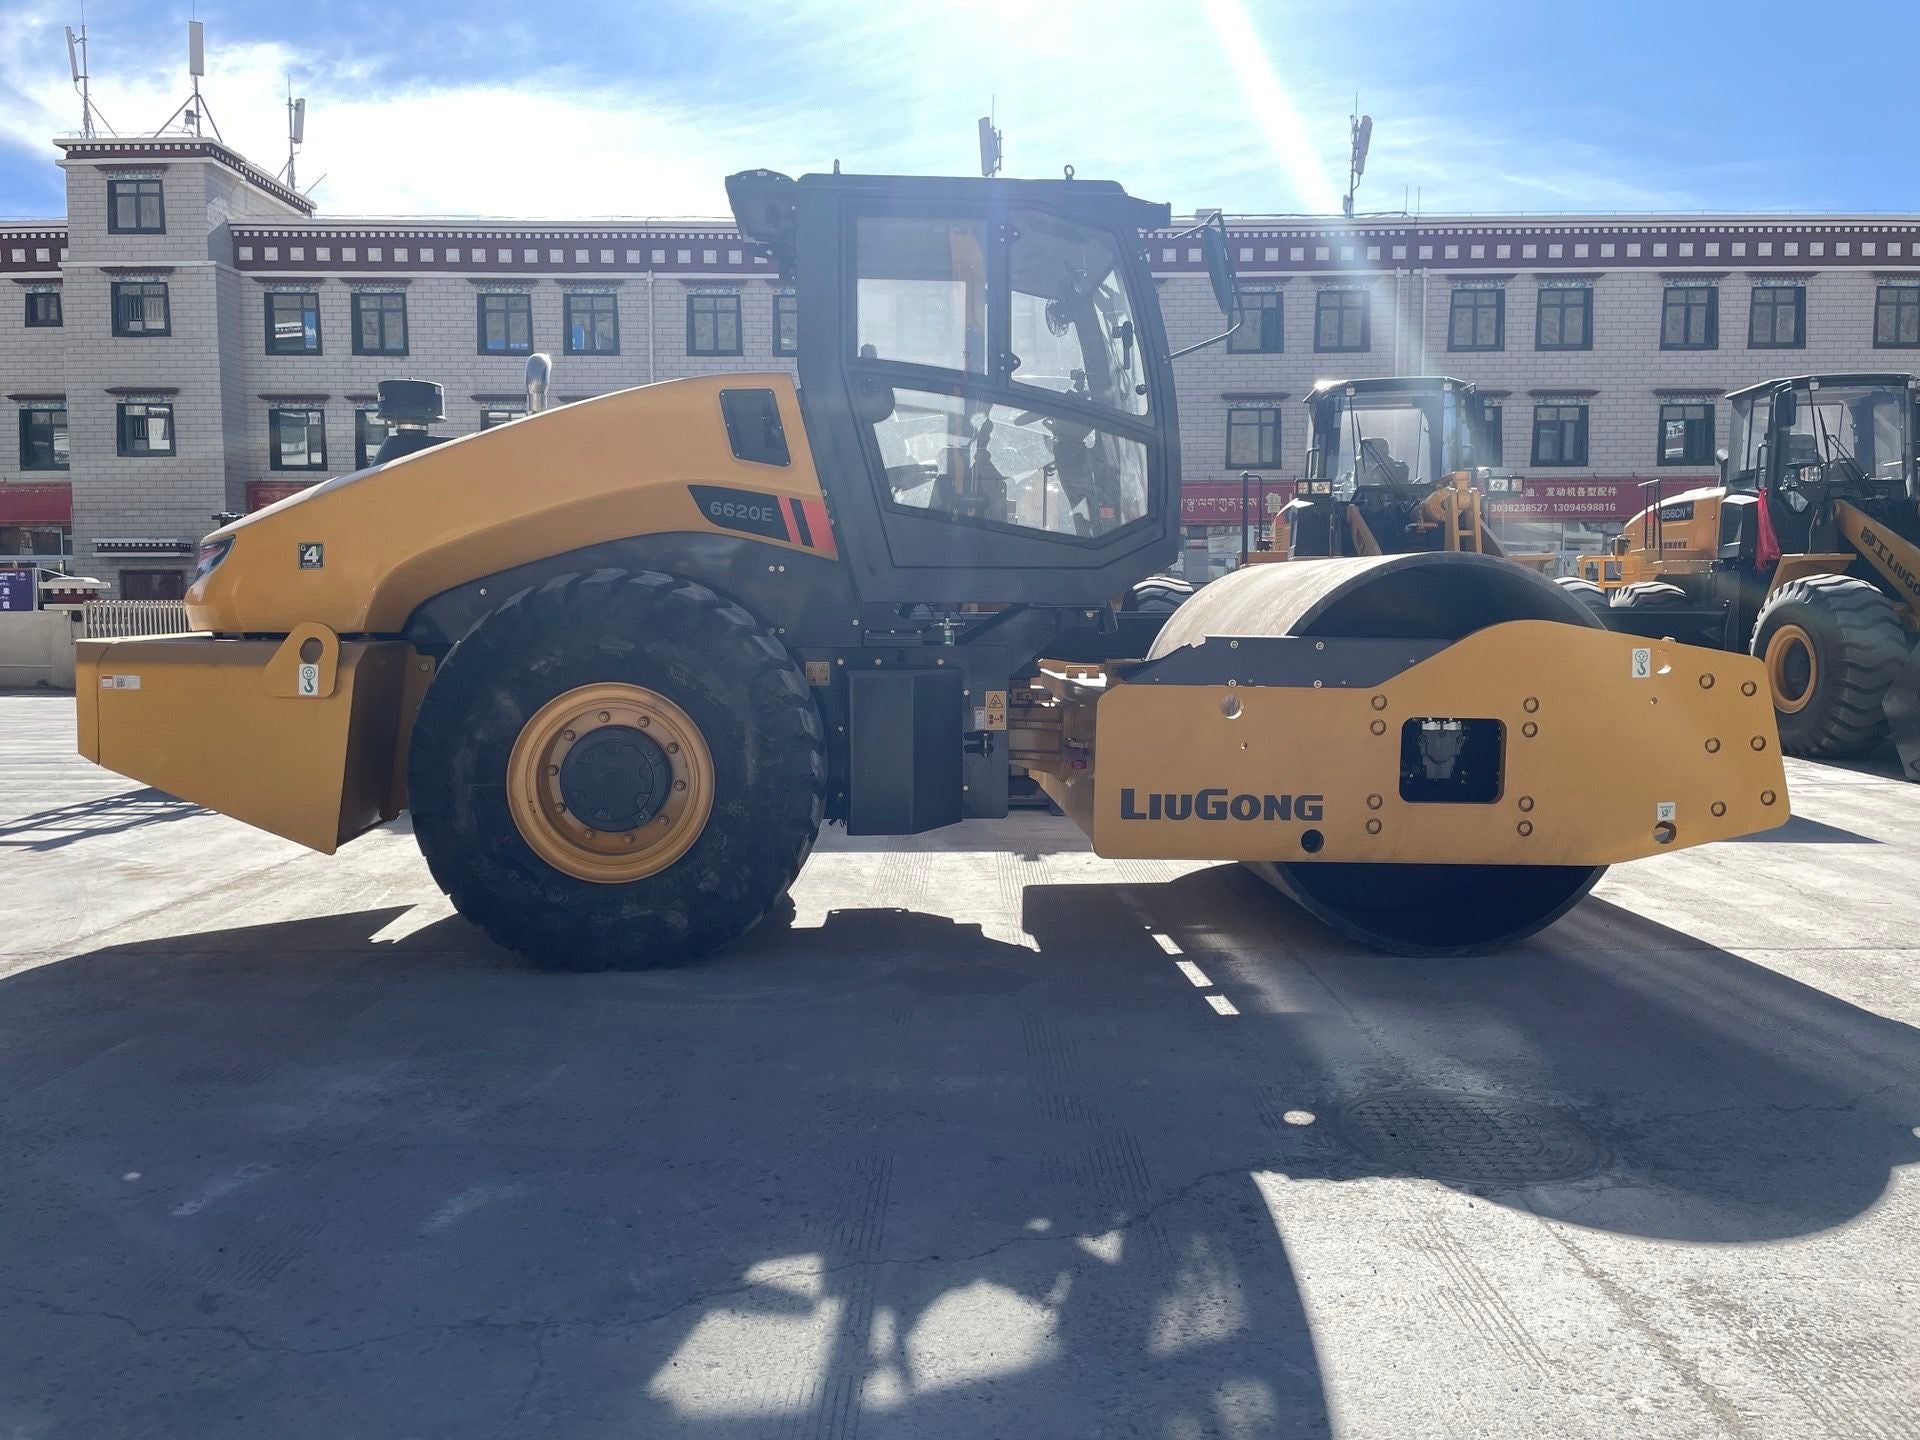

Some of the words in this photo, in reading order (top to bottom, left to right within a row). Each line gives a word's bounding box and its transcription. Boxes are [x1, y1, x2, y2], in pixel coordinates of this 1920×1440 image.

[1520, 486, 1618, 497] 油、发动机各型配件
[710, 501, 773, 522] 6620E
[1490, 503, 1549, 512] 3038238527
[1553, 503, 1617, 512] 13094598816
[303, 545, 319, 563] 4
